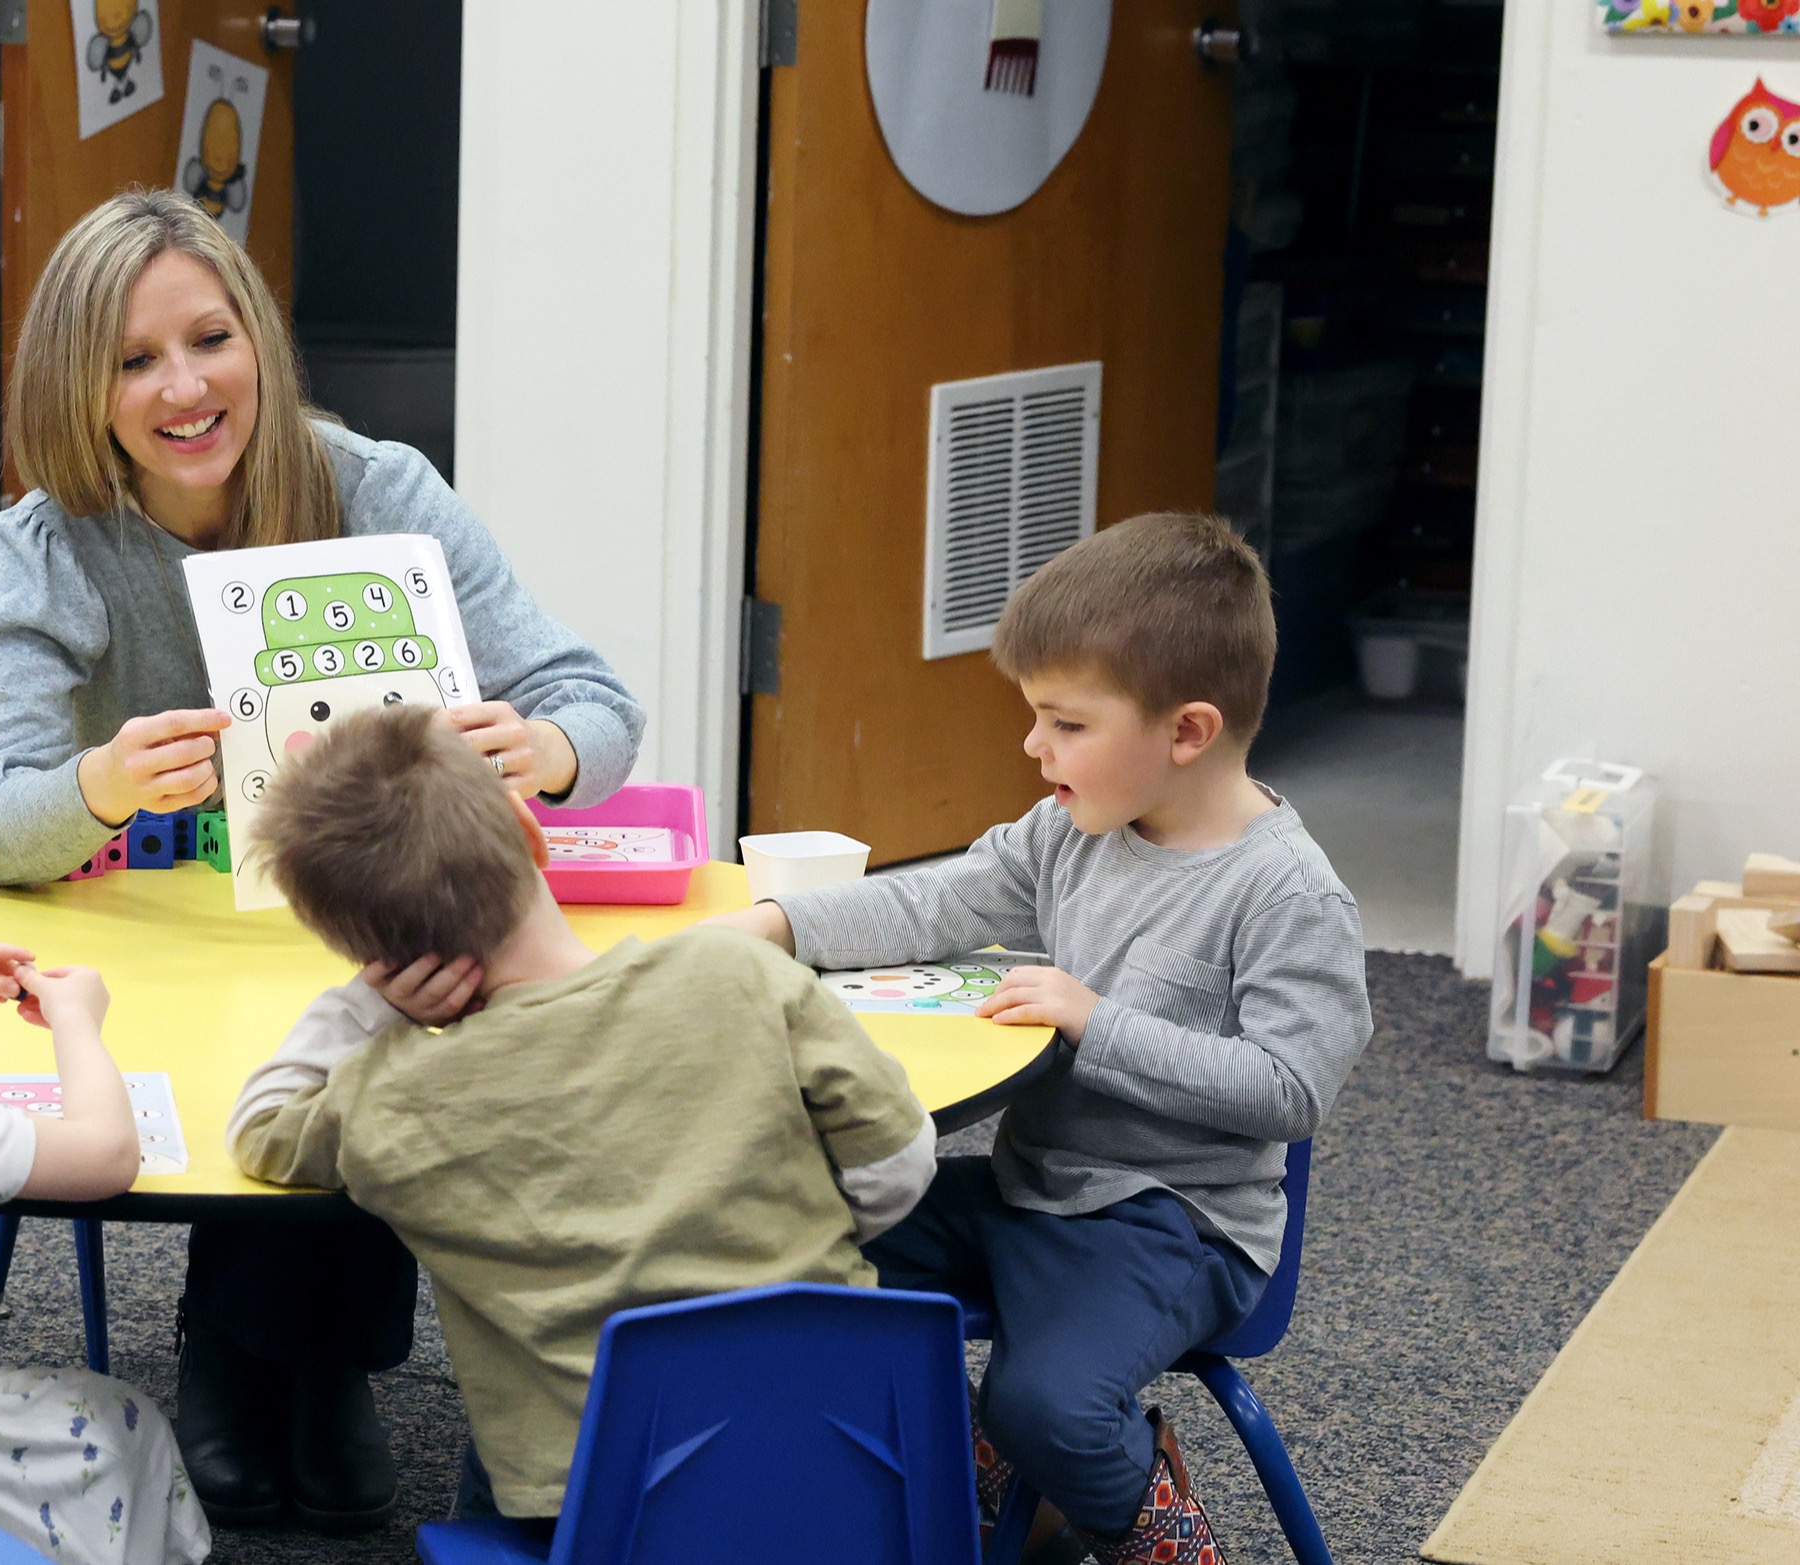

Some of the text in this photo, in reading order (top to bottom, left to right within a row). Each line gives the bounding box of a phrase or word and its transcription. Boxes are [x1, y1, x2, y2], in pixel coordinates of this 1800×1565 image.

[412, 572, 428, 595] 5
[231, 586, 247, 608] 2
[285, 595, 299, 616] 1
[370, 588, 384, 608] 4
[331, 605, 349, 627] 5
[280, 640, 416, 678] 5 3 2 6
[447, 670, 460, 694] 1
[238, 693, 255, 717] 6
[251, 776, 266, 799] 3
